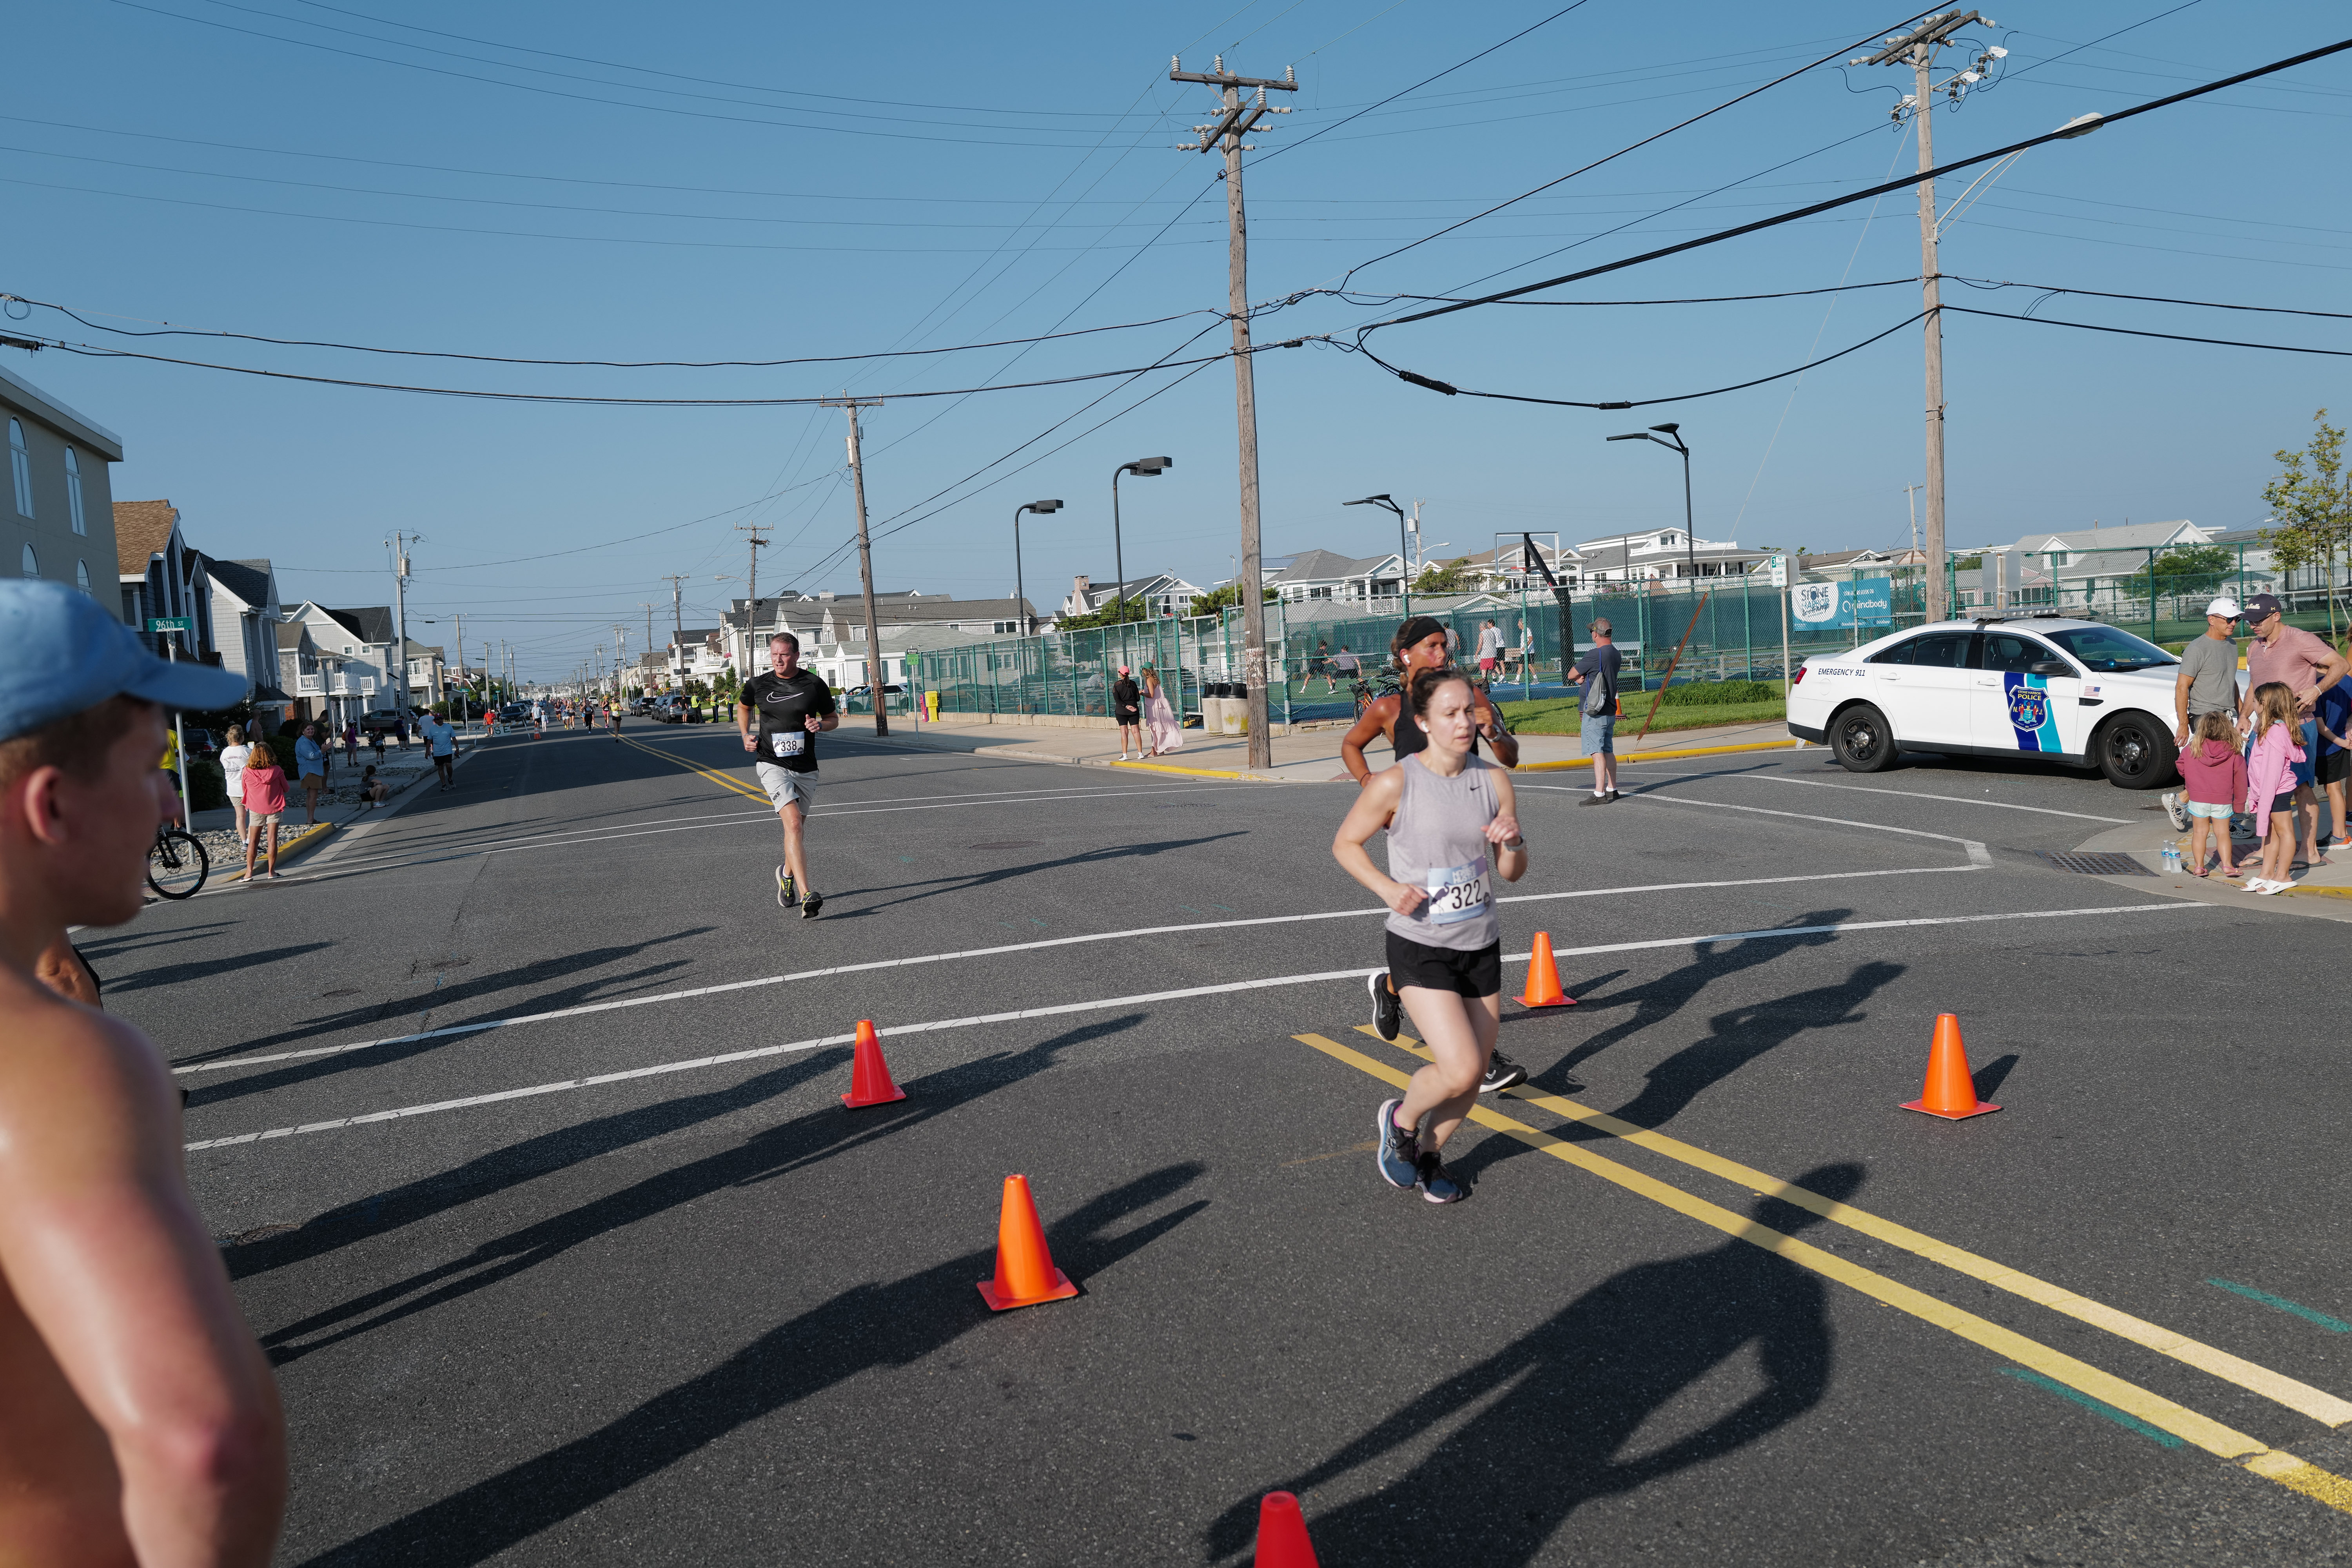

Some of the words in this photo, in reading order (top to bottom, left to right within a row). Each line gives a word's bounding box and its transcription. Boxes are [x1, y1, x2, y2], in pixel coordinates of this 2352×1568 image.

[156, 620, 175, 630] 96th
[780, 740, 797, 751] 338
[1451, 879, 1482, 909] 322
